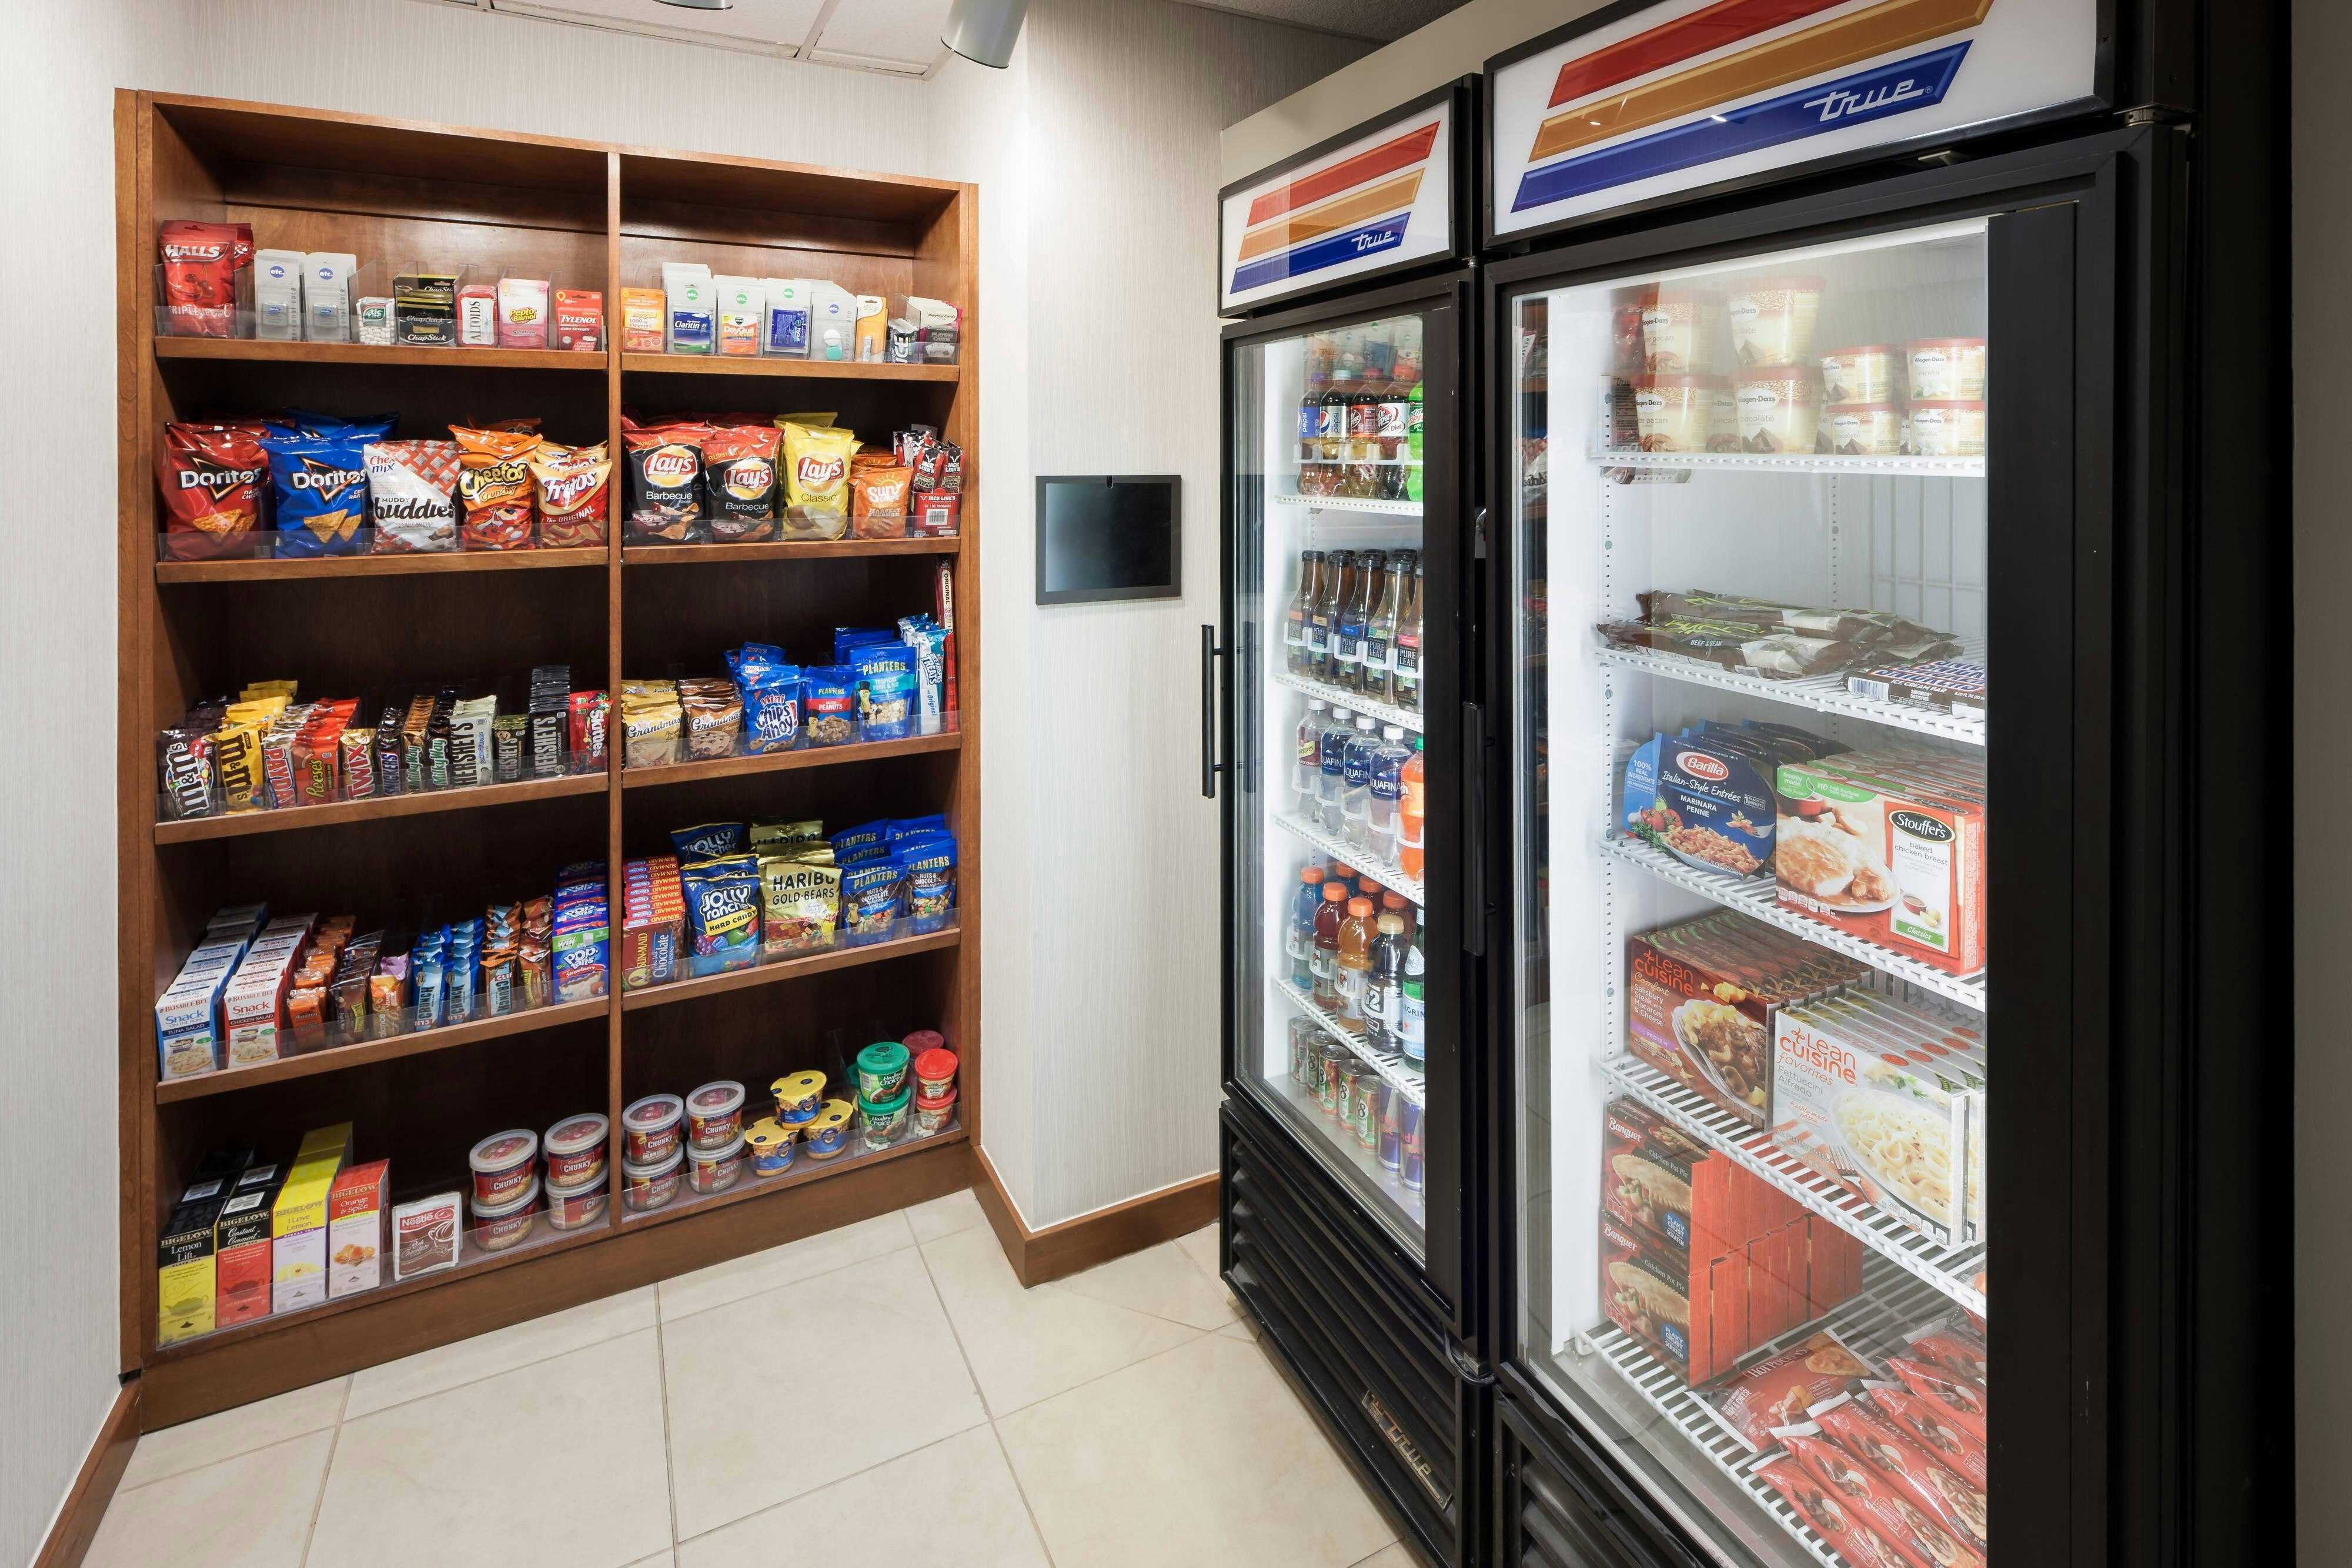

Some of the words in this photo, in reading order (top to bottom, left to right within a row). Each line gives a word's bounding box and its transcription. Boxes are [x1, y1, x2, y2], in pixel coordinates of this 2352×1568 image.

[1351, 230, 1395, 252] true
[164, 245, 220, 258] HALLS
[509, 307, 537, 317] Pepto-
[560, 315, 596, 323] TYLENOL
[470, 301, 480, 341] ALTOIDS
[675, 320, 700, 329] Claritin
[724, 327, 754, 335] DayQuil
[1646, 417, 1668, 426] pecan
[370, 456, 396, 465] Chex
[647, 454, 693, 476] Lay's
[800, 457, 842, 483] Lay's
[181, 468, 262, 488] Doritos
[293, 470, 366, 489] Doritos
[459, 462, 528, 499] Cheetos
[729, 469, 769, 488] Lay's
[480, 486, 516, 502] Crunchy
[646, 492, 692, 500] Barbecue
[801, 493, 837, 502] Classic
[375, 497, 454, 519] buddies
[1342, 637, 1355, 647] PURE
[1342, 644, 1354, 653] LEAF
[1369, 641, 1385, 651] PURE
[1369, 648, 1384, 658] LEAF
[1399, 648, 1416, 660] PURE
[863, 661, 906, 676] PLANTERS
[1399, 656, 1415, 667] LEAF
[920, 657, 937, 685] TREATS
[756, 706, 790, 727] Chips
[590, 710, 603, 757] Skittles
[533, 717, 557, 778] HERSHEY'S
[1633, 760, 1652, 771] 100%
[1636, 768, 1648, 776] REAL
[1687, 757, 1724, 775] Barilla
[265, 748, 295, 808] PAYDA
[1628, 772, 1655, 784] INGREDIENTS
[1783, 772, 1802, 782] freshly
[1662, 771, 1709, 794] Italian-Style
[1711, 785, 1741, 802] Entrées
[1818, 782, 1828, 791] no
[1681, 795, 1717, 811] MARINARA
[1748, 800, 1764, 808] MINUTE
[1686, 805, 1709, 817] PENNE
[1897, 814, 1946, 838] Stouffer's
[835, 833, 876, 850] PLANTERS
[1909, 841, 1933, 854] baked
[1895, 844, 1923, 861] chicken
[1925, 852, 1947, 866] breast
[773, 871, 835, 891] HARIBO
[854, 871, 898, 890] PLANTERS
[701, 885, 750, 911] JOLLY
[773, 888, 834, 905] GOLD-BEARS
[861, 890, 888, 902] CHOCOLATE
[709, 921, 730, 931] HARD
[733, 910, 757, 923] CANDY
[1907, 926, 1932, 941] Classics
[654, 934, 669, 978] Chocolate
[566, 965, 596, 978] Strawberry
[1635, 972, 1669, 997] Comfort
[233, 992, 260, 1002] BUMBLE
[450, 984, 465, 1015] CRUNCH
[1635, 984, 1663, 1004] Salisbury
[1635, 991, 1652, 1005] Steak
[165, 1001, 193, 1013] BUMBLE
[233, 1002, 269, 1014] Snack
[418, 986, 435, 1019] CRUNCH
[1634, 998, 1663, 1019] Macaroni
[166, 1010, 204, 1024] Snack
[230, 1017, 255, 1025] CHICKEN
[1641, 1009, 1663, 1027] Cheese
[185, 1024, 205, 1032] SALAD
[1646, 1031, 1668, 1047] PROTEIN
[1778, 1065, 1823, 1094] Fettuccini
[1778, 1074, 1812, 1098] Alfredo
[1788, 1099, 1810, 1118] freshly
[1810, 1109, 1829, 1124] made
[706, 1123, 730, 1134] CHUNKY
[1609, 1118, 1642, 1142] Banquet
[648, 1135, 672, 1149] CHUNKY
[564, 1159, 592, 1172] CHUNKY
[1649, 1149, 1669, 1167] Chicken
[1670, 1163, 1678, 1173] Pot
[1679, 1169, 1688, 1178] Pie
[493, 1176, 522, 1191] CHUNKY
[332, 1184, 377, 1199] BIGELOW
[276, 1201, 322, 1216] BIGELOW
[340, 1197, 368, 1208] Orange
[348, 1203, 369, 1214] Spice
[220, 1211, 269, 1228] BIGELOW
[286, 1221, 312, 1231] Lemon
[1668, 1215, 1685, 1229] FLAKY
[1668, 1221, 1684, 1237] CRUST
[161, 1229, 213, 1246] BIGELOW
[1604, 1223, 1637, 1252] Banquet
[1667, 1229, 1684, 1247] SCRATCH
[172, 1241, 202, 1254] Lemon
[178, 1252, 193, 1261] Lift
[1645, 1259, 1665, 1278] Chicken
[1666, 1275, 1675, 1285] Pot
[1676, 1281, 1685, 1291] Pie
[1665, 1342, 1683, 1359] SCRATCH
